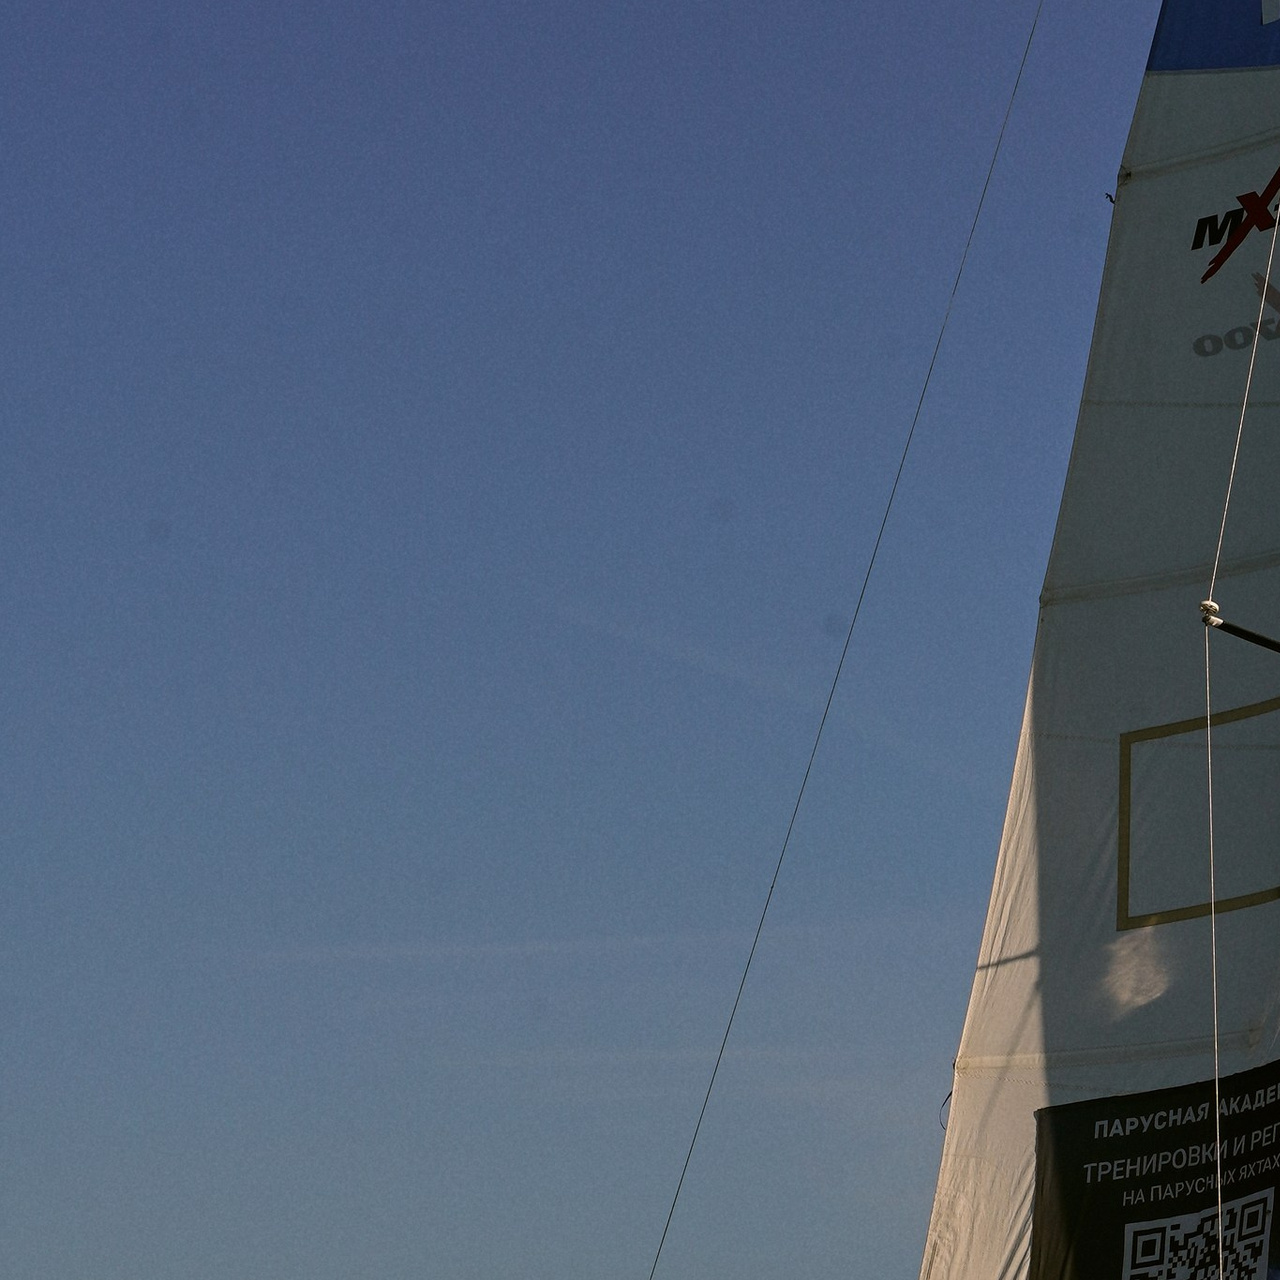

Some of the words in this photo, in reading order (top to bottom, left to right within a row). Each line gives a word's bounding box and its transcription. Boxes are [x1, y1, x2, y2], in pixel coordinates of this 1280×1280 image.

[1094, 1101, 1210, 1139] ПАРУСНАЯ
[1083, 1139, 1228, 1184] ТРЕНИРОВКИ
[1233, 1135, 1246, 1157] И
[1122, 1188, 1146, 1207] НА
[1150, 1167, 1237, 1202] ПАРУСНЫХ
